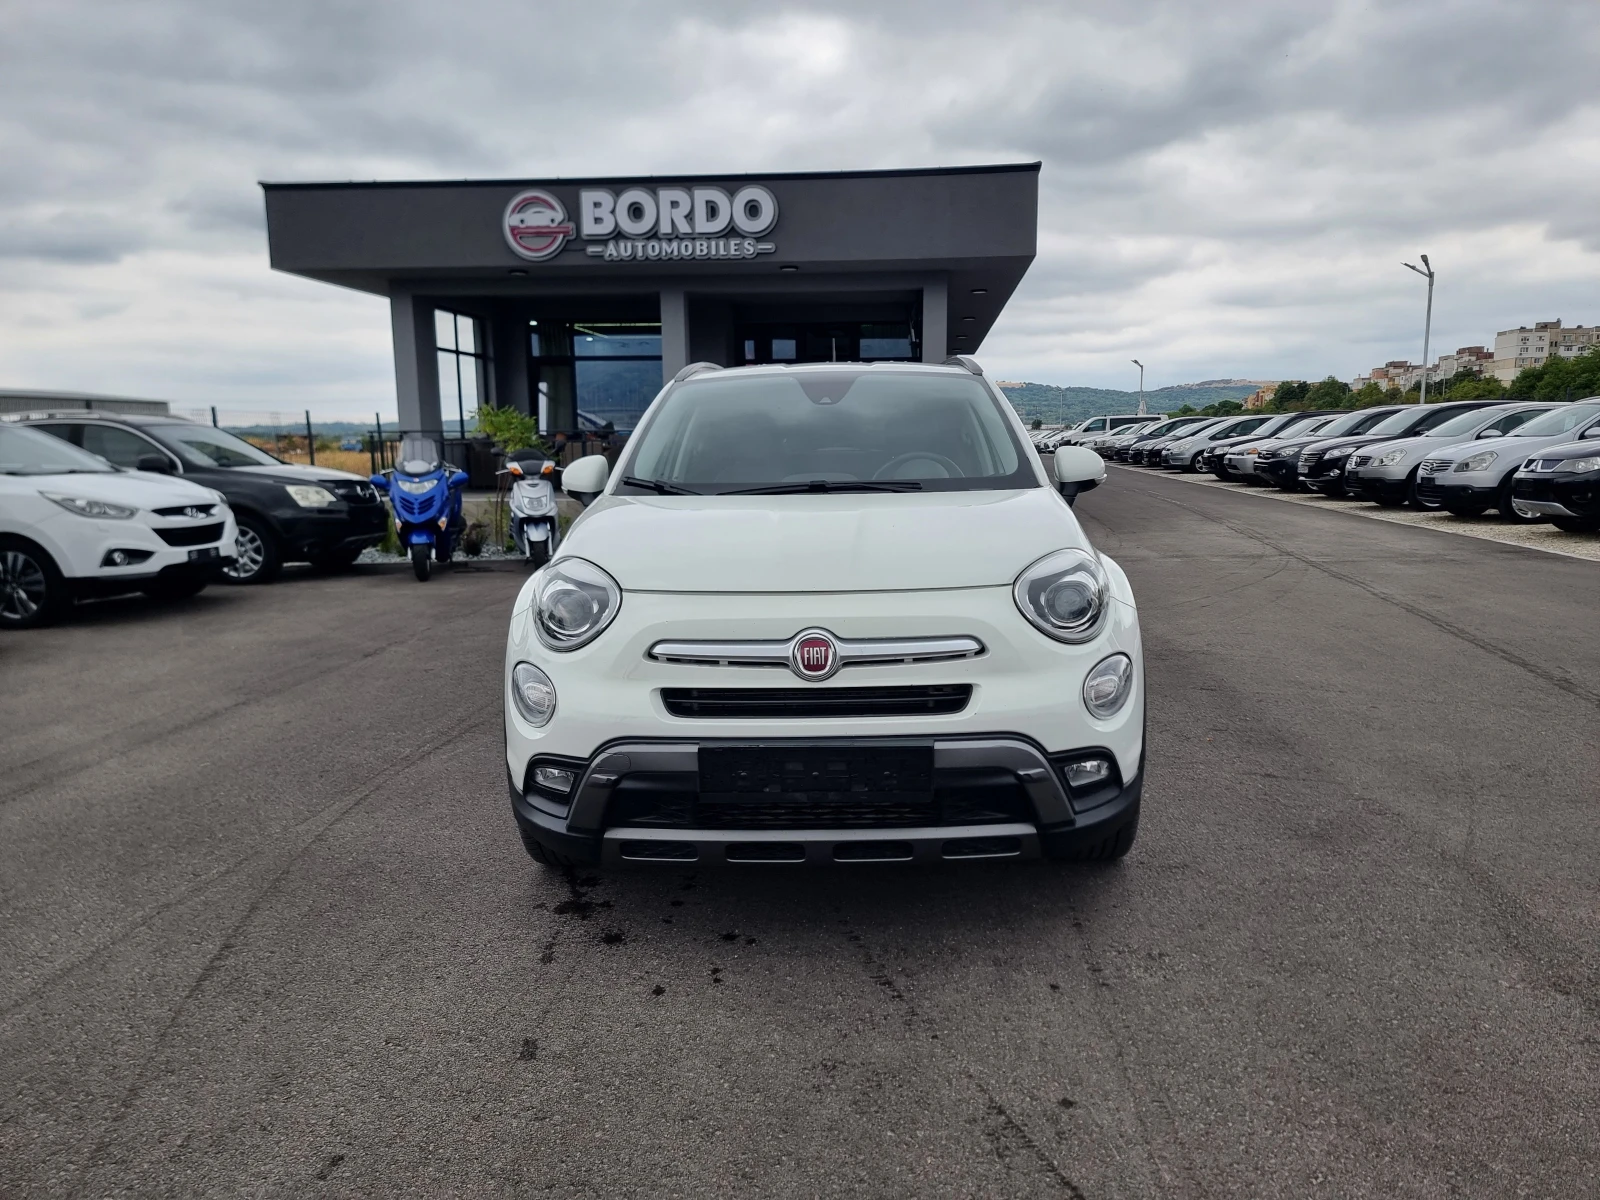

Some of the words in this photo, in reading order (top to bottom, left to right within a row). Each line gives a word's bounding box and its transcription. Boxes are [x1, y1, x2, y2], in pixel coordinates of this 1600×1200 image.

[580, 187, 776, 235] BORDO
[606, 240, 755, 258] AUTOMOBILES
[803, 646, 827, 665] FIAT
